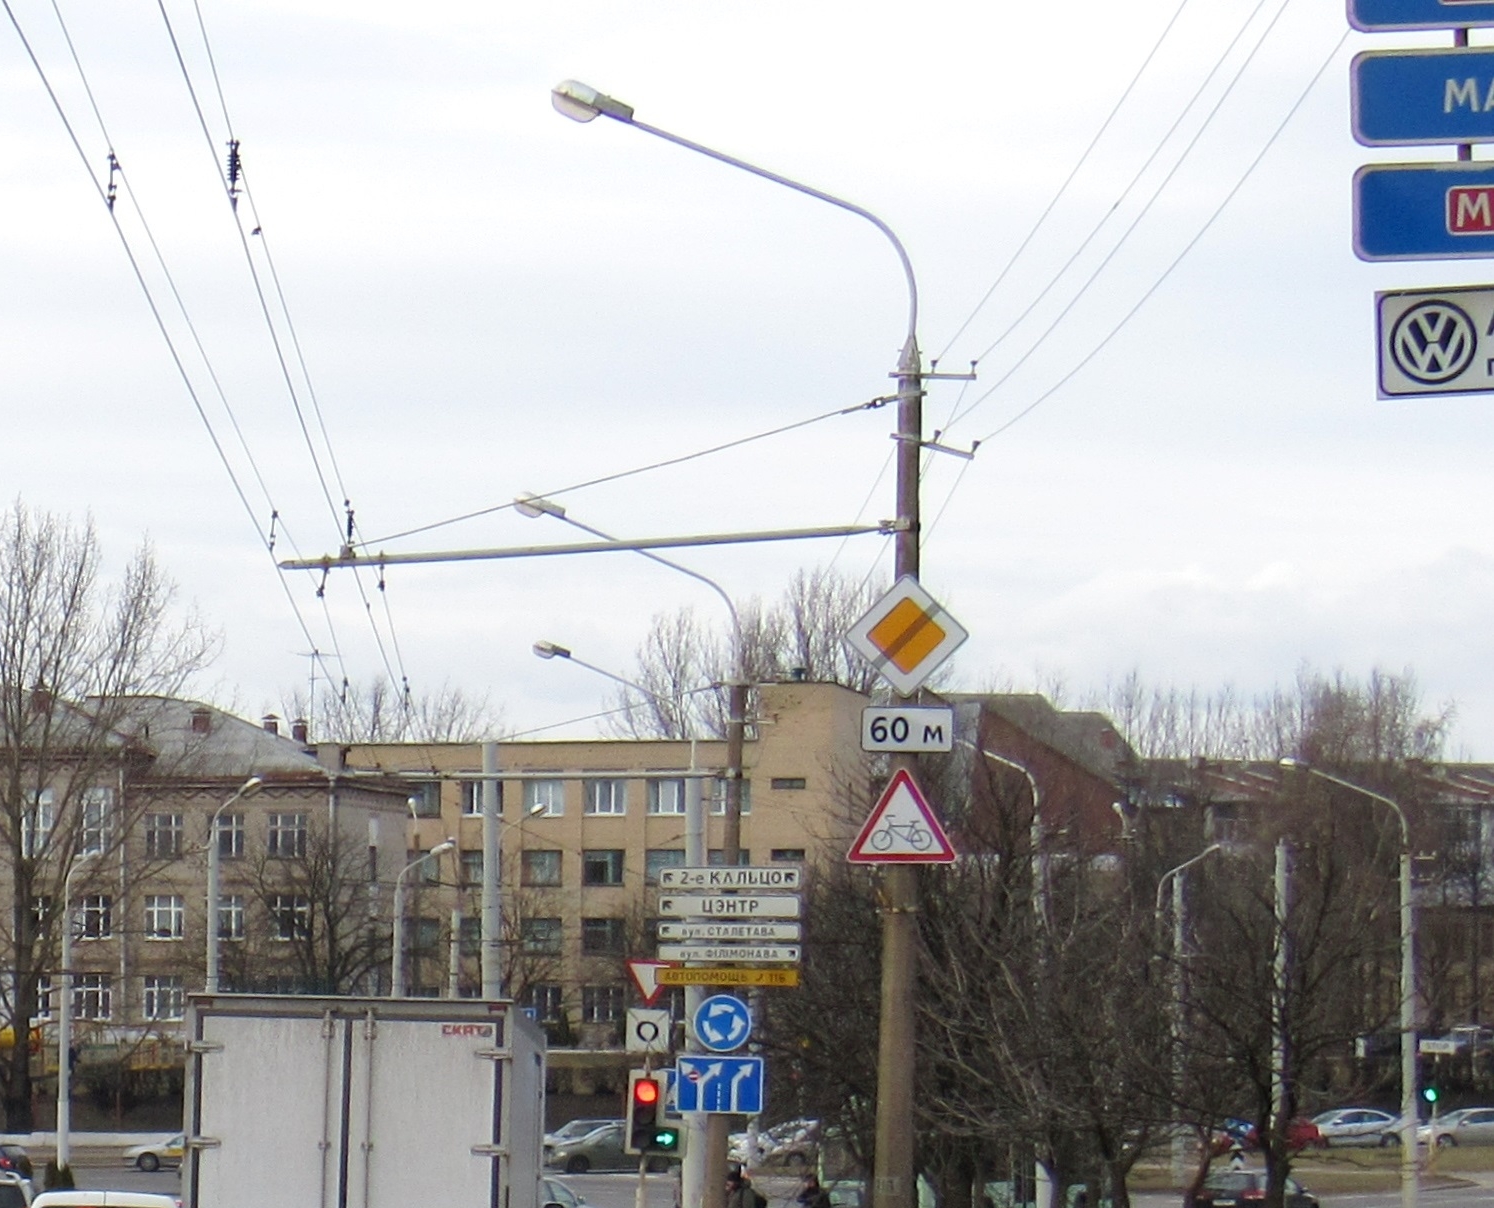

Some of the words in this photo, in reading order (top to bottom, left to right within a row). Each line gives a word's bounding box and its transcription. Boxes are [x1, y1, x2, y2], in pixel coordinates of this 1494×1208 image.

[869, 716, 909, 744] 60
[679, 870, 705, 885] 2-е
[709, 870, 782, 887] КАЛЬЦО
[701, 899, 759, 915] ЦЭНТР
[681, 928, 705, 939] вул.
[707, 927, 777, 937] СТАЛЕТАВА
[704, 949, 779, 959] ФІЛІМОНАВА
[664, 971, 748, 983] АВТОПОМОЩЬ
